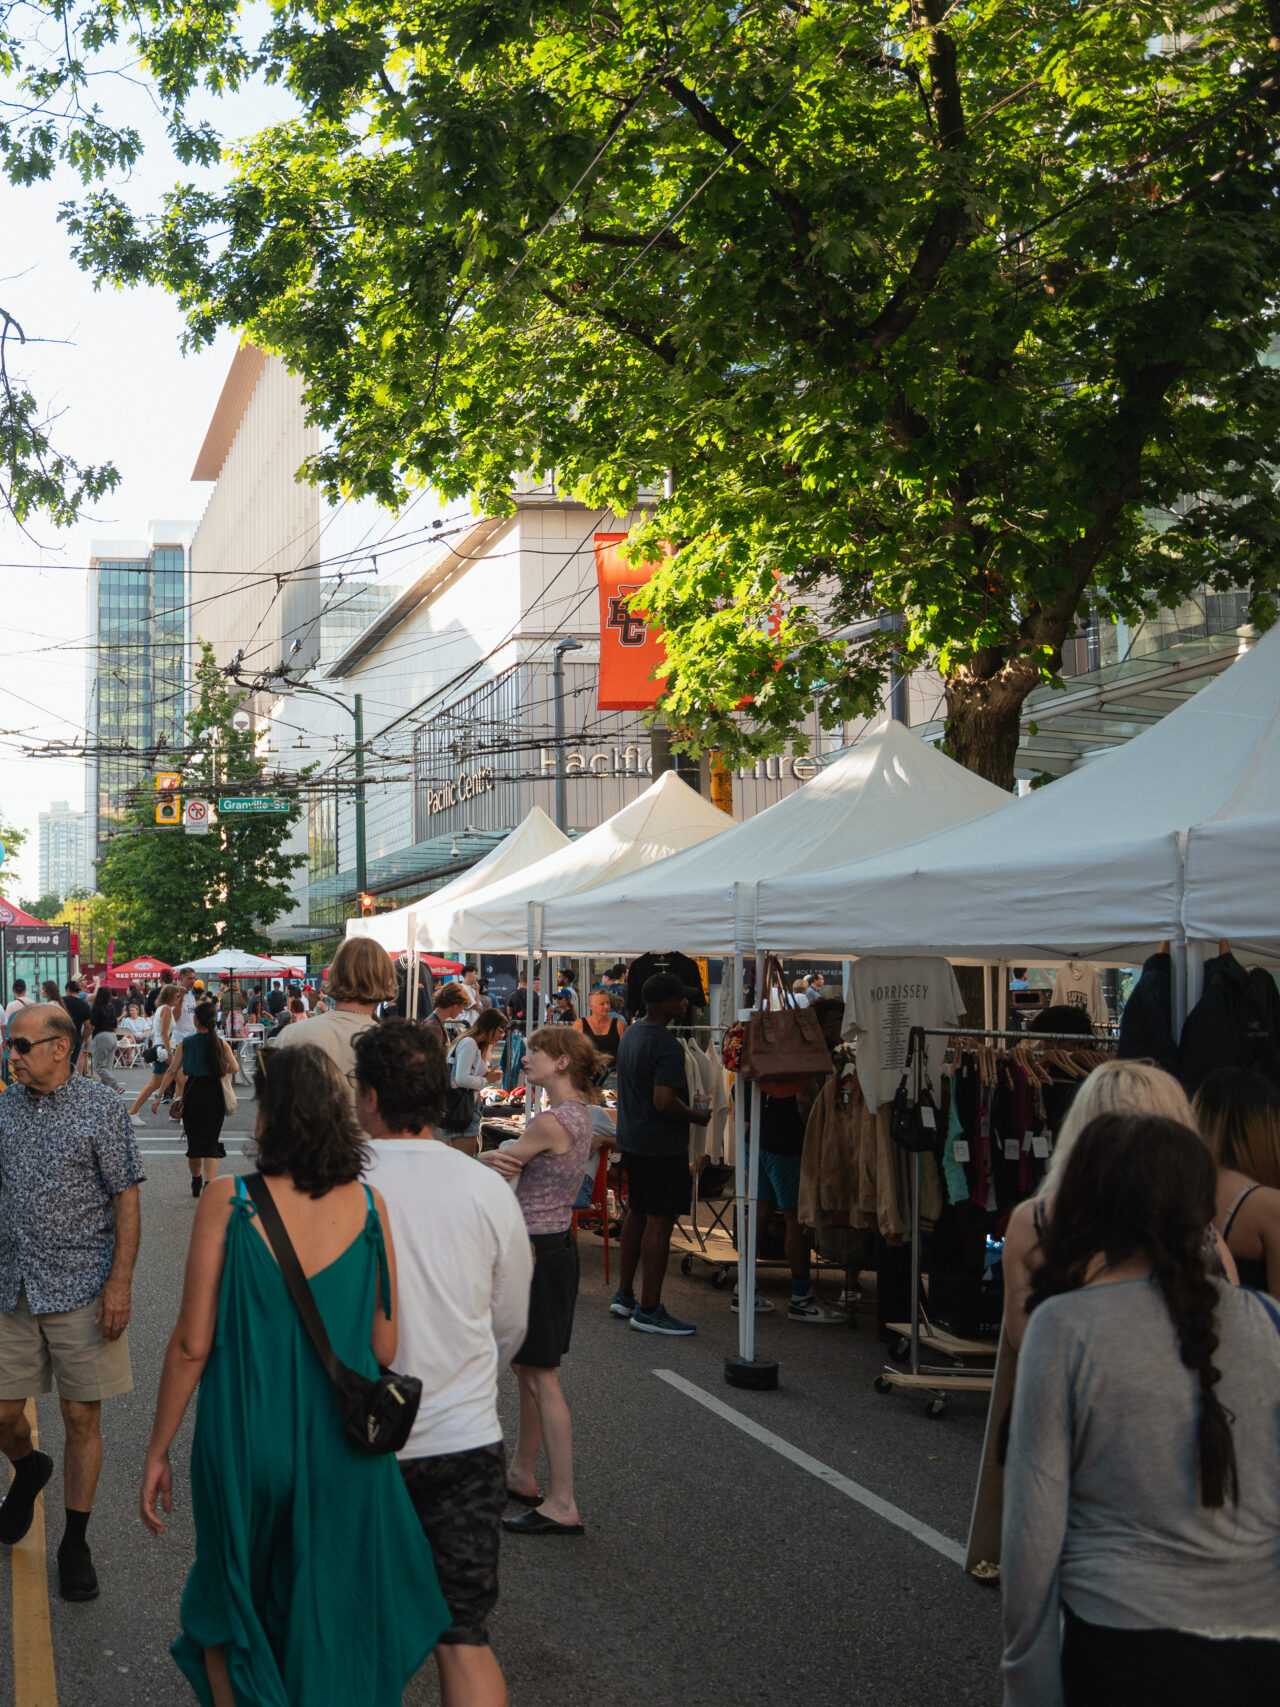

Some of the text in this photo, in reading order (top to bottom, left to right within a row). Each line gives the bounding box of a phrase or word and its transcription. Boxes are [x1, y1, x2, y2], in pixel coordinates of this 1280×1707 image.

[427, 766, 494, 816] Pacific Centre
[223, 800, 269, 809] Granville
[289, 977, 318, 991] EXIT
[870, 984, 929, 1002] MORRISSEY
